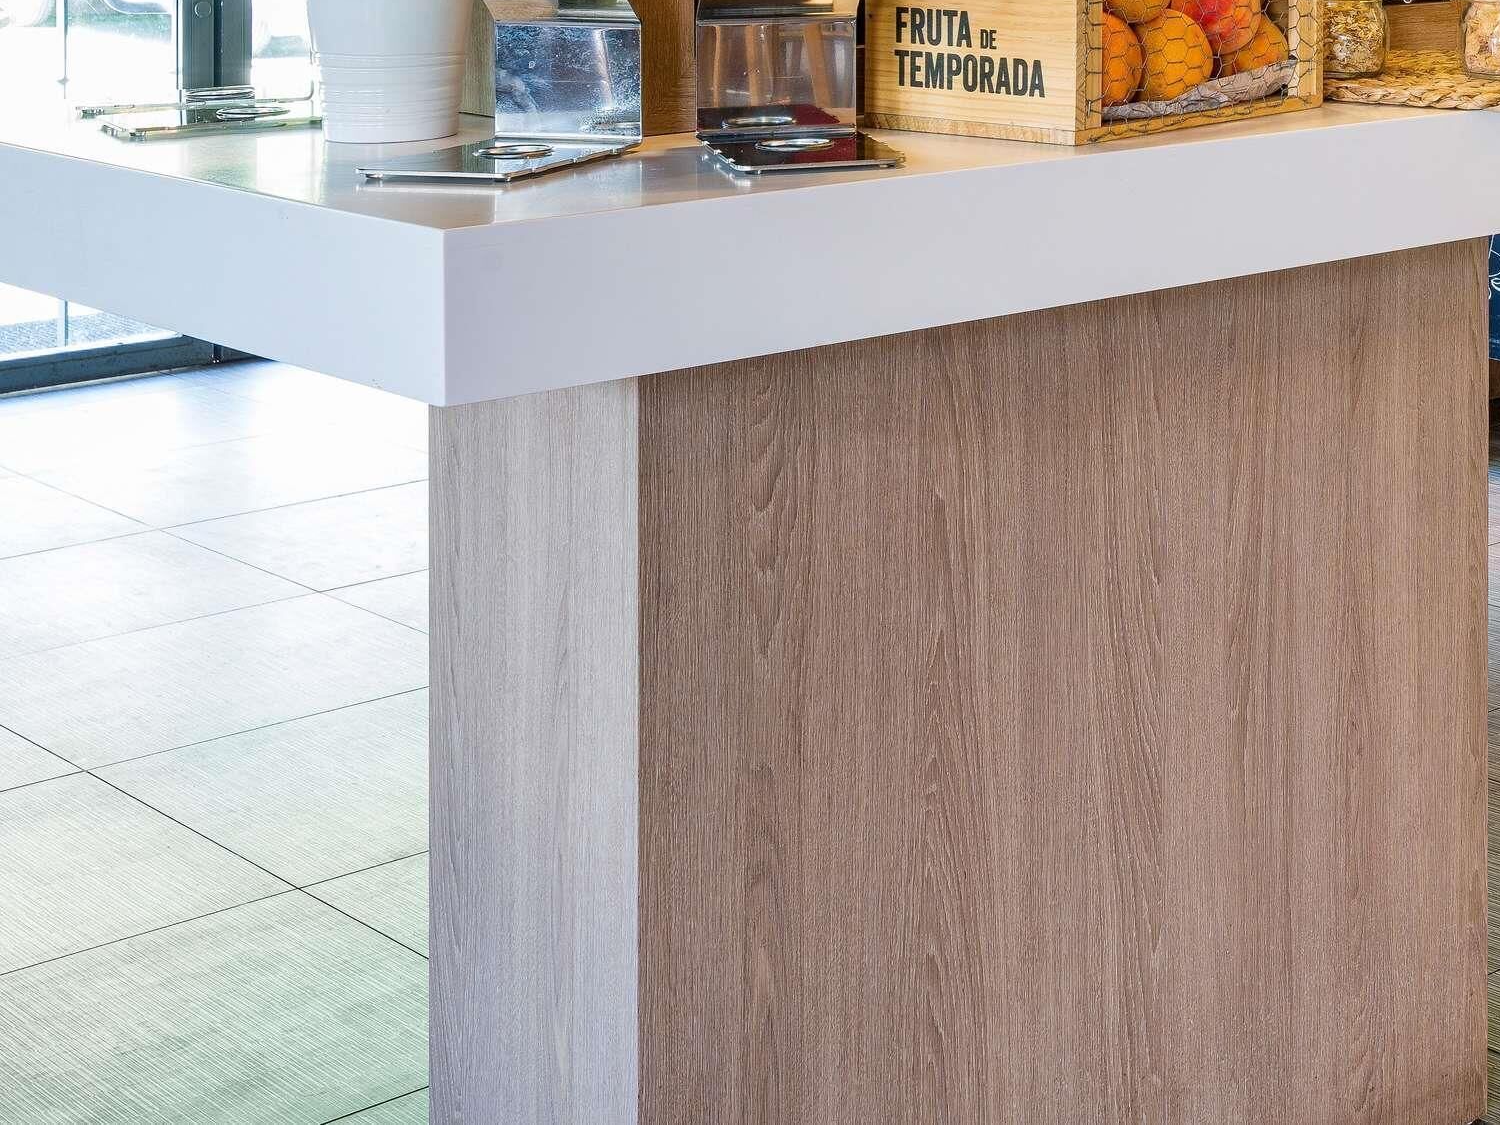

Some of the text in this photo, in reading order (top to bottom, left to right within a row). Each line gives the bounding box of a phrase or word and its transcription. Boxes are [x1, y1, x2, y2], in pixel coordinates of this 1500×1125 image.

[895, 6, 997, 49] FRUTA DE
[894, 49, 1046, 98] TEMPORADA
